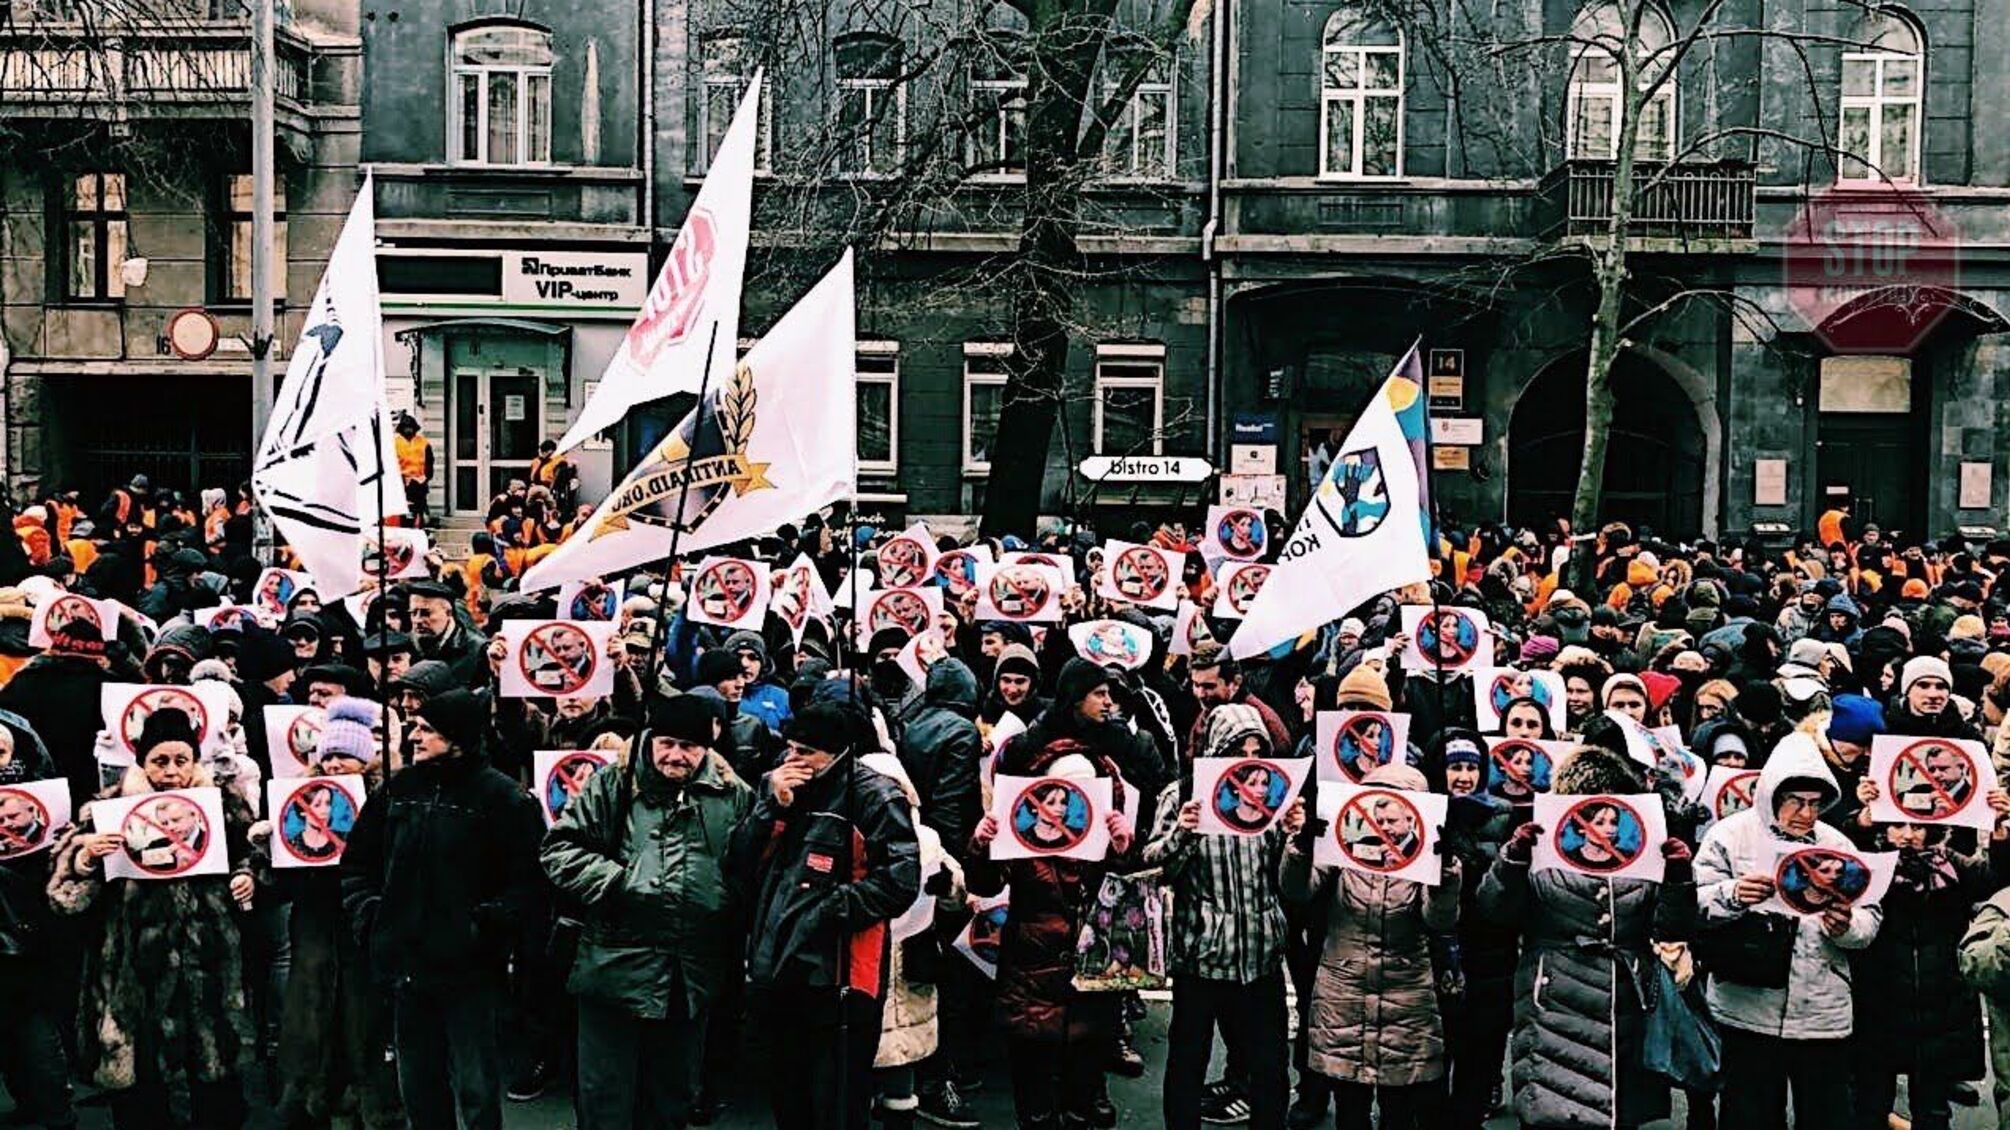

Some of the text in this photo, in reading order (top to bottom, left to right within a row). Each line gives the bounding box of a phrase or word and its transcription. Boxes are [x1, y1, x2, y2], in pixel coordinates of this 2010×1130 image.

[540, 263, 632, 277] ПриватБанк
[535, 281, 618, 301] VIP-центр
[156, 335, 171, 355] 16
[1439, 356, 1456, 369] 14
[1111, 460, 1180, 475] bistro 14
